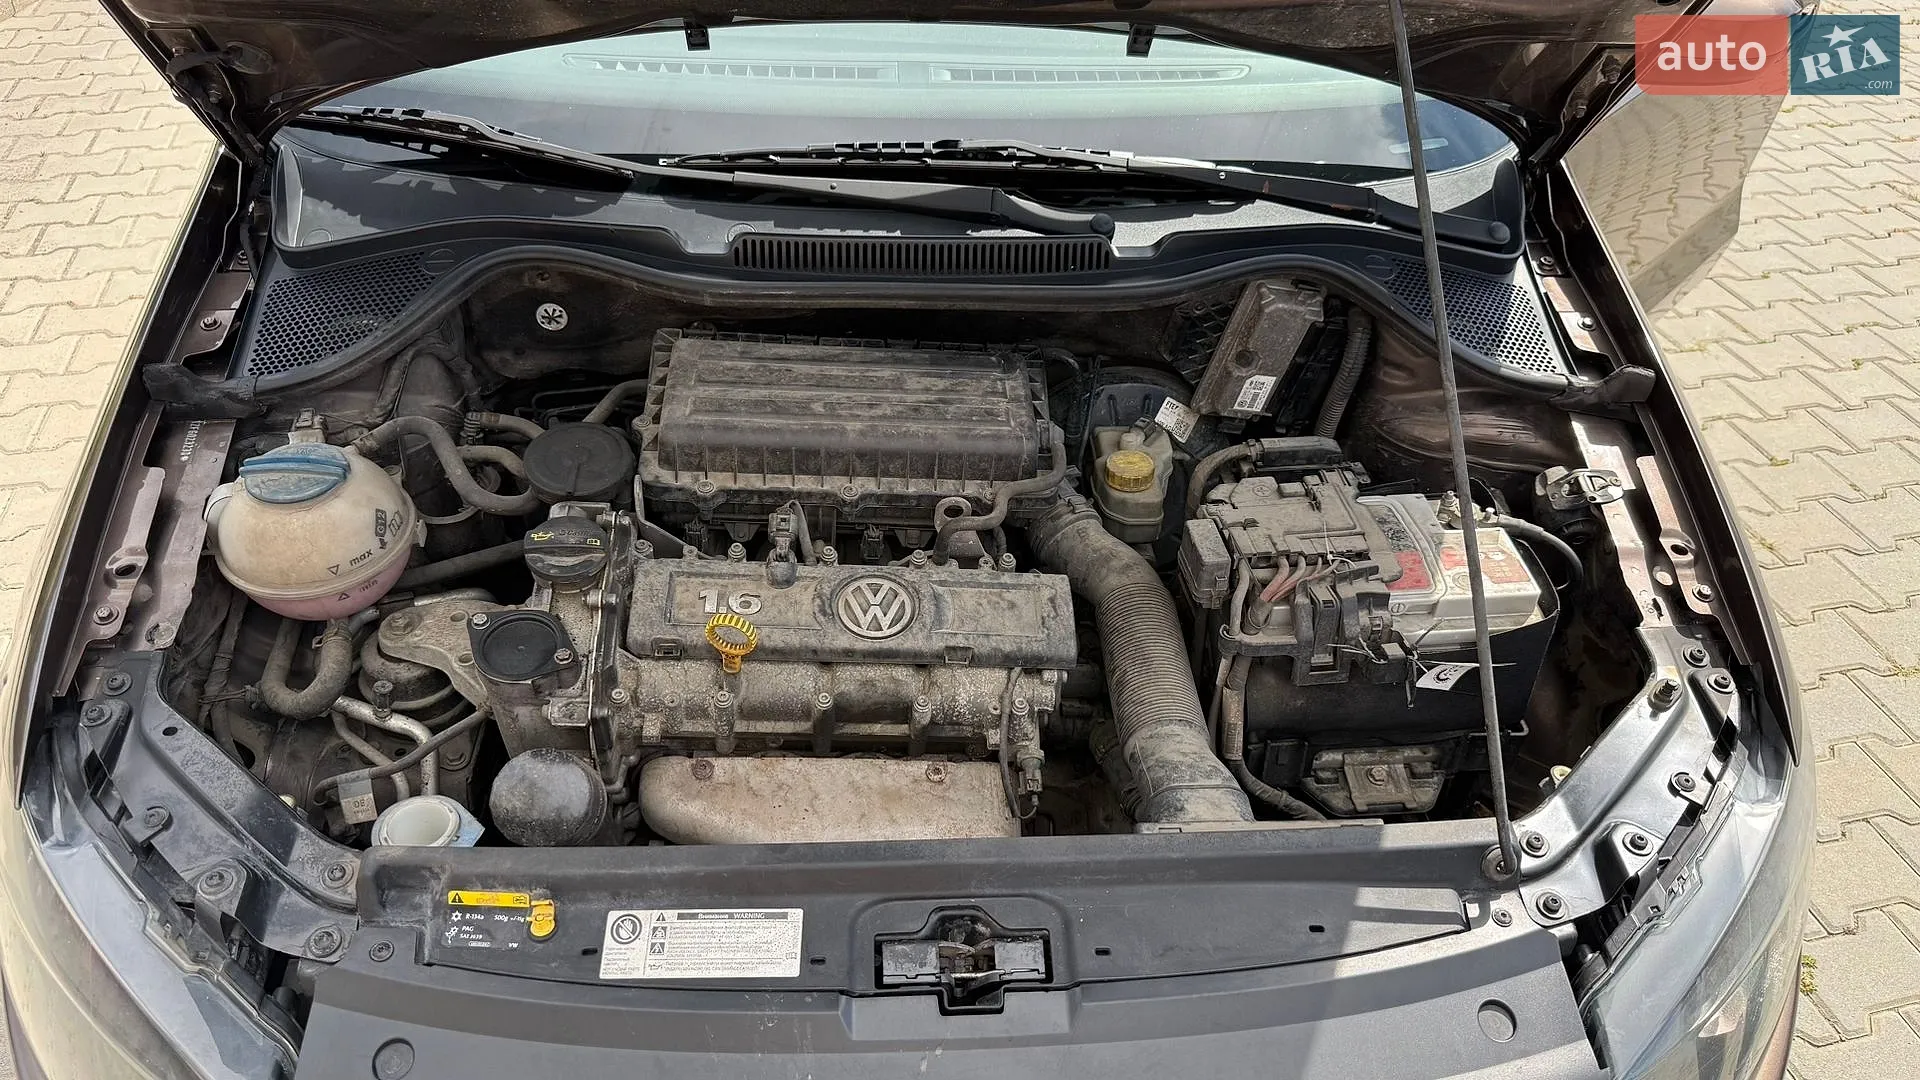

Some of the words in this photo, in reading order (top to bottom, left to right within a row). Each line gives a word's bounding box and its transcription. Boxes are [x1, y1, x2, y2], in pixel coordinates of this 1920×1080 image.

[350, 549, 373, 566] max
[360, 580, 378, 593] min
[699, 590, 762, 615] 1.6
[838, 577, 912, 633] VW
